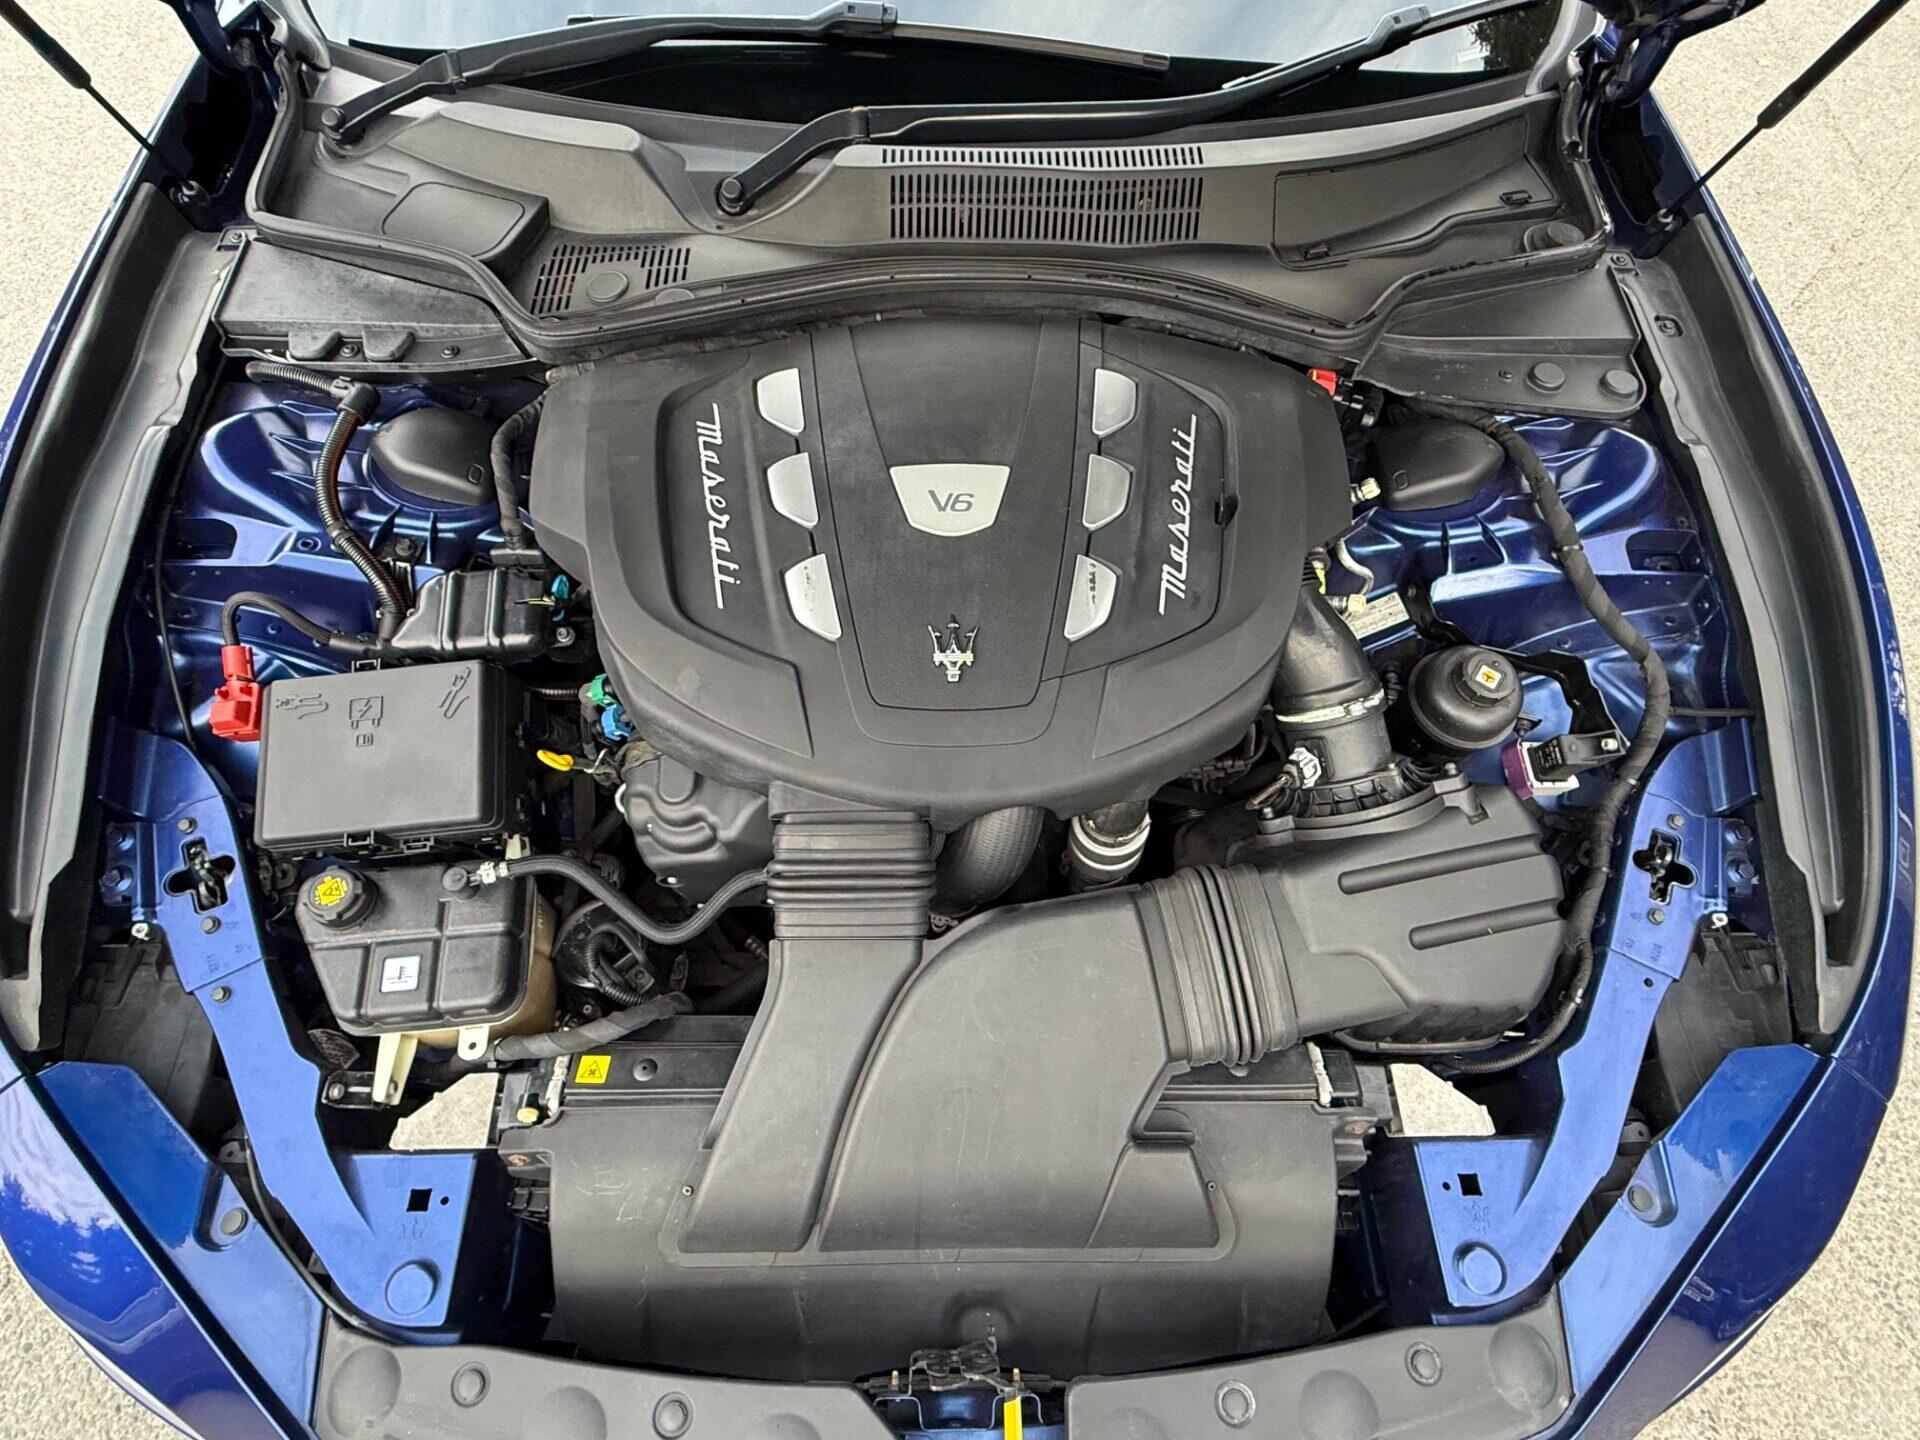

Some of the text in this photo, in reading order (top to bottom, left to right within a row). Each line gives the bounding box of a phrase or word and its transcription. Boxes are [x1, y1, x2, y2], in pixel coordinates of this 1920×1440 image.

[696, 403, 741, 609] Maserati
[927, 490, 974, 513] V6
[1158, 414, 1198, 615] Maserati
